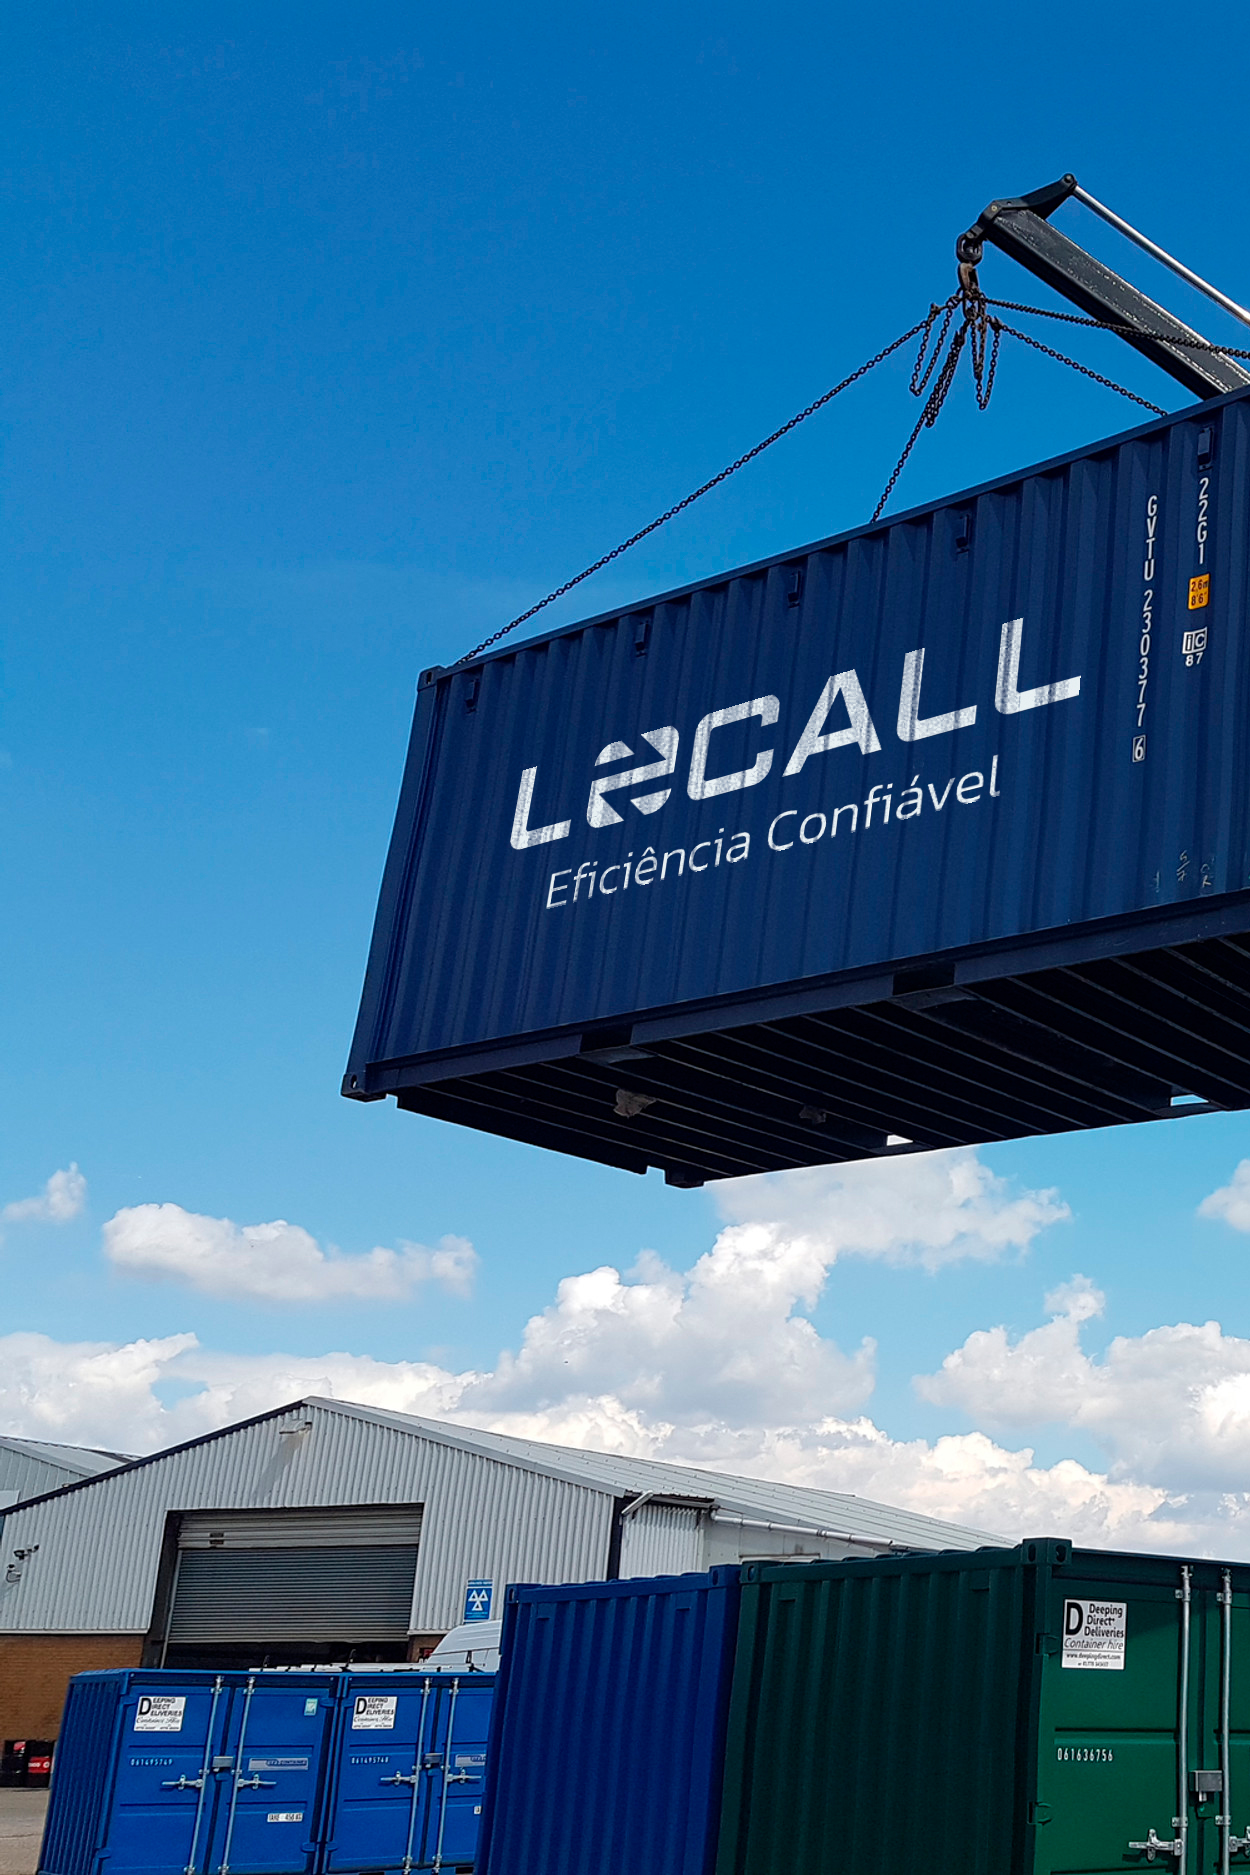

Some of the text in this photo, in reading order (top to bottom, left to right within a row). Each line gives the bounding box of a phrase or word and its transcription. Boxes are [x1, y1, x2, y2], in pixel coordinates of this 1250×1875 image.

[1197, 477, 1209, 564] 22G1
[1132, 495, 1158, 762] GVTU 230377 6
[1185, 652, 1203, 667] 87
[546, 754, 1000, 909] Eficiência Confiável
[1089, 1603, 1123, 1618] Deeping
[1084, 1626, 1124, 1638] Deliveries
[1064, 1637, 1123, 1650] Container hire
[1057, 1747, 1114, 1762] 061636756
